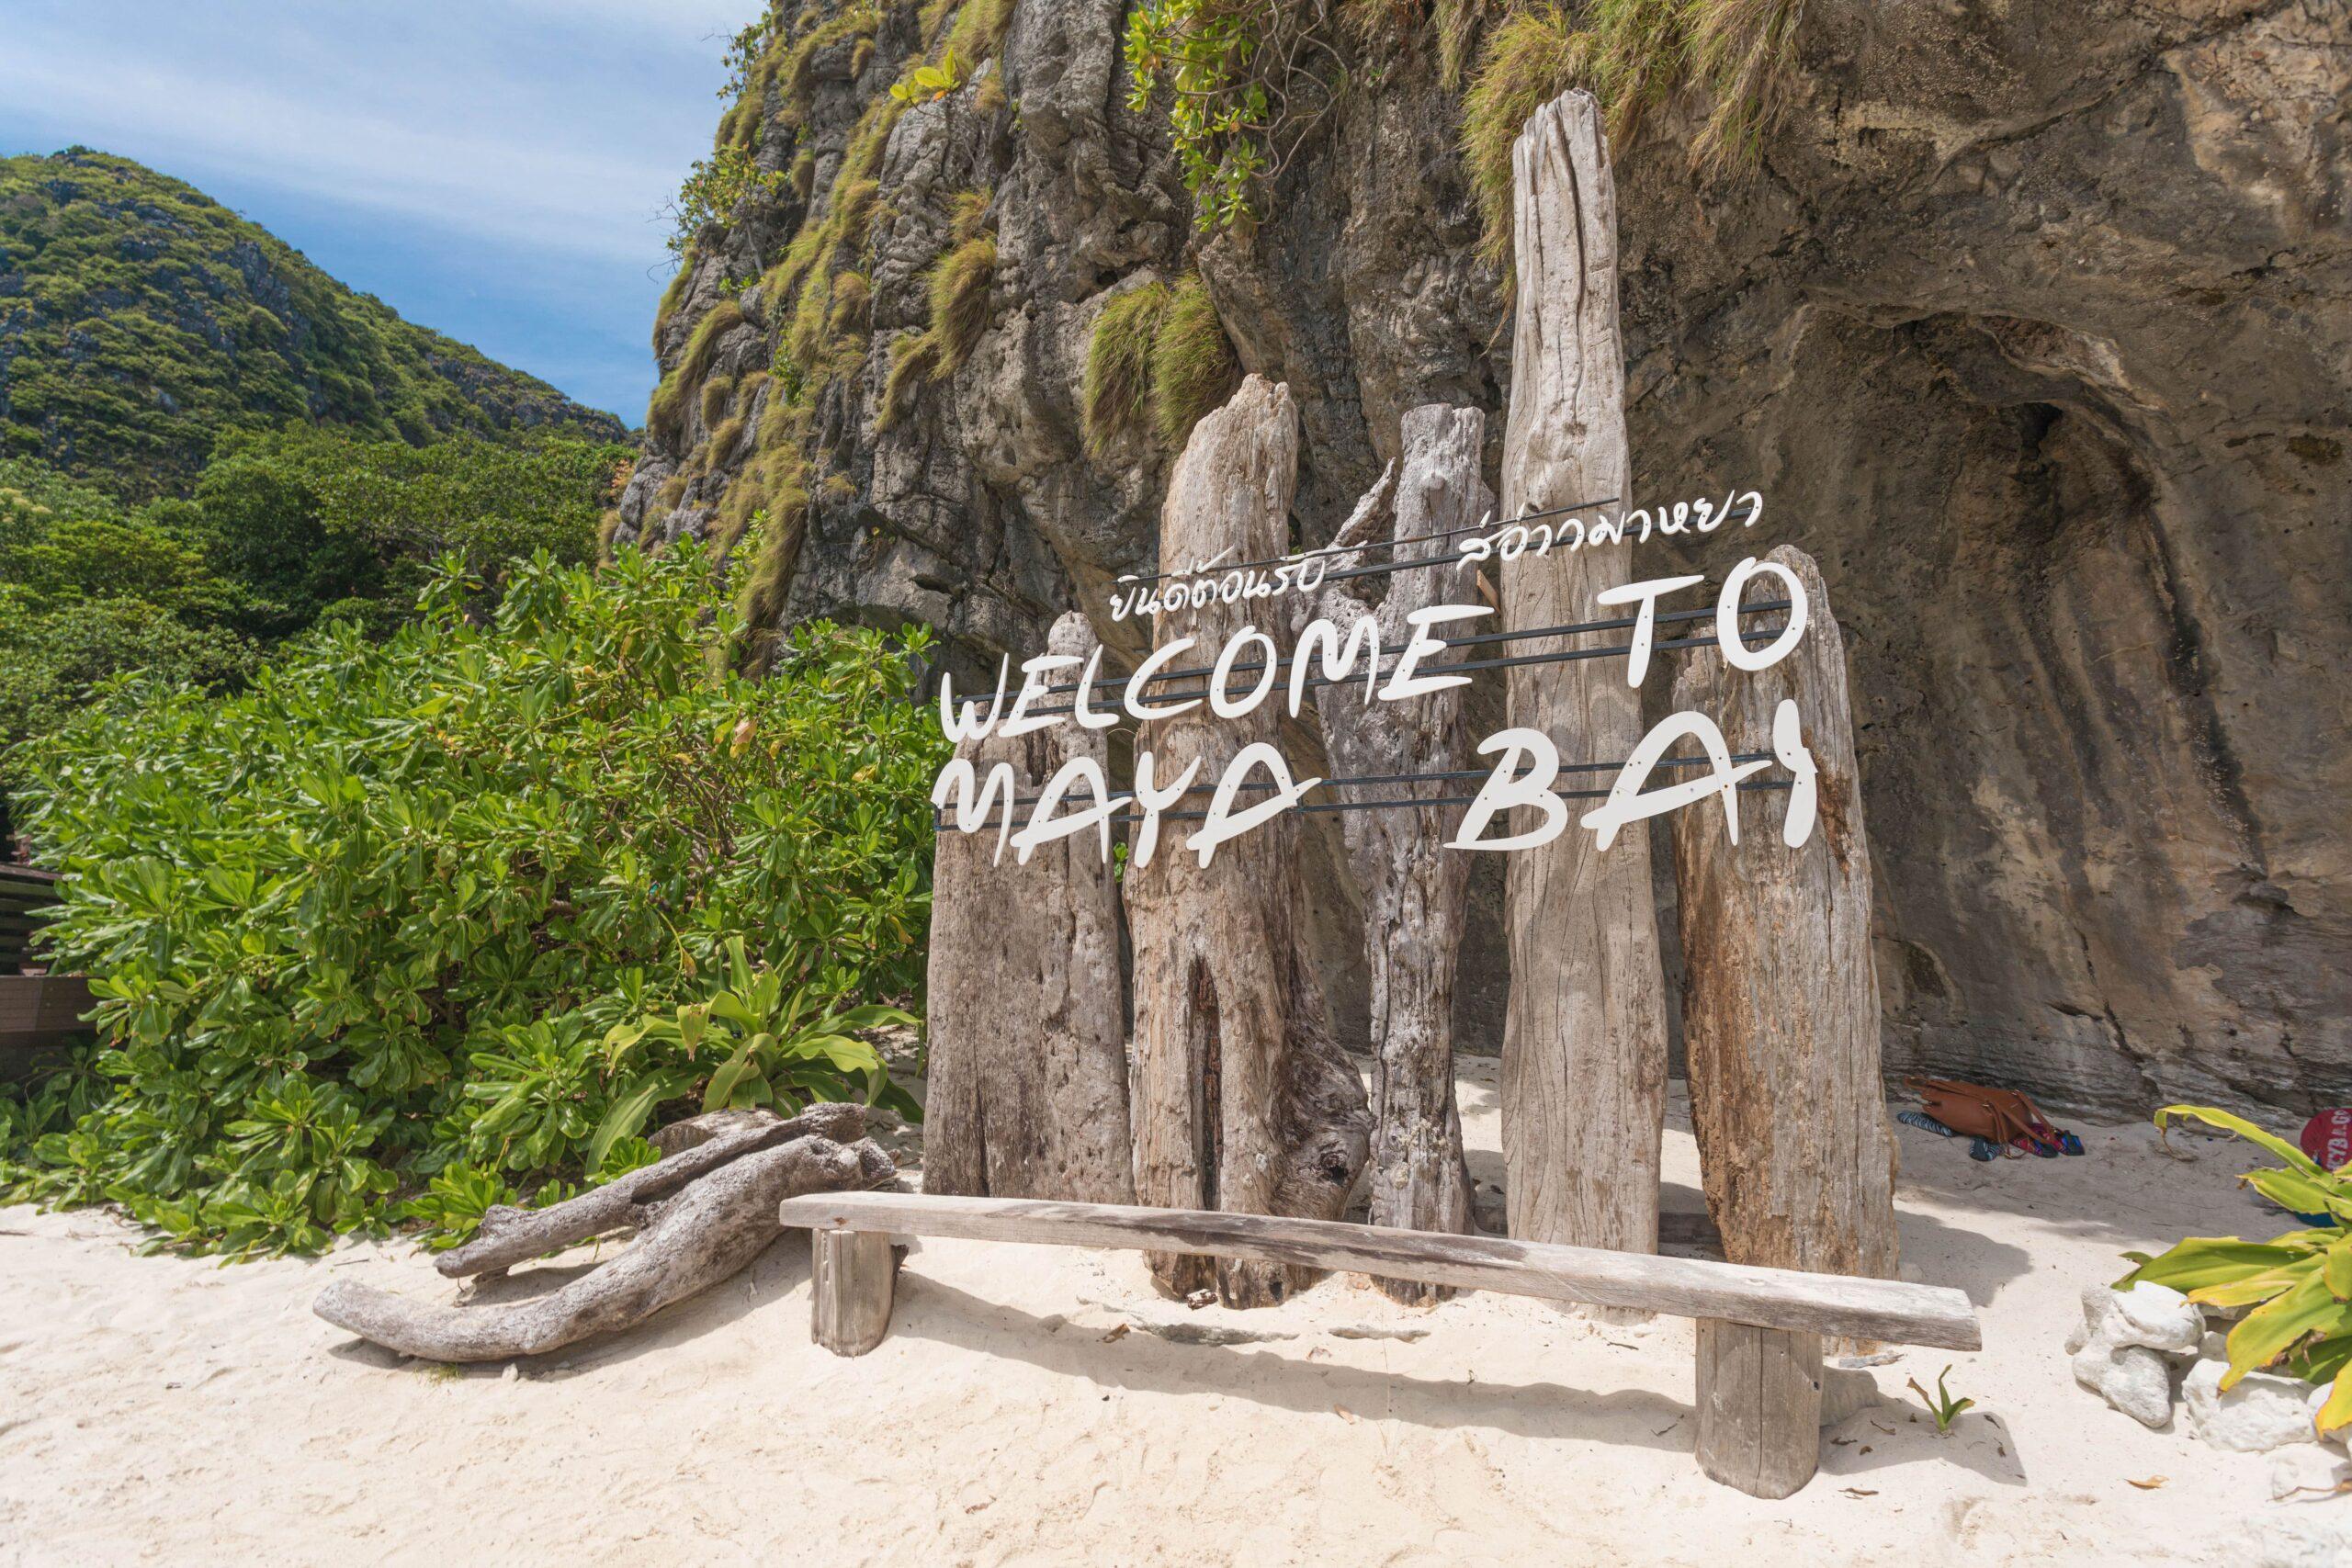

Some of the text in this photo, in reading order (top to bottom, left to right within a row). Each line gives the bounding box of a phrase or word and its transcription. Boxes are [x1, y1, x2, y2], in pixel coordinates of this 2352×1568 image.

[940, 557, 1809, 742] WELCOME TO
[931, 741, 1323, 869] MAYA
